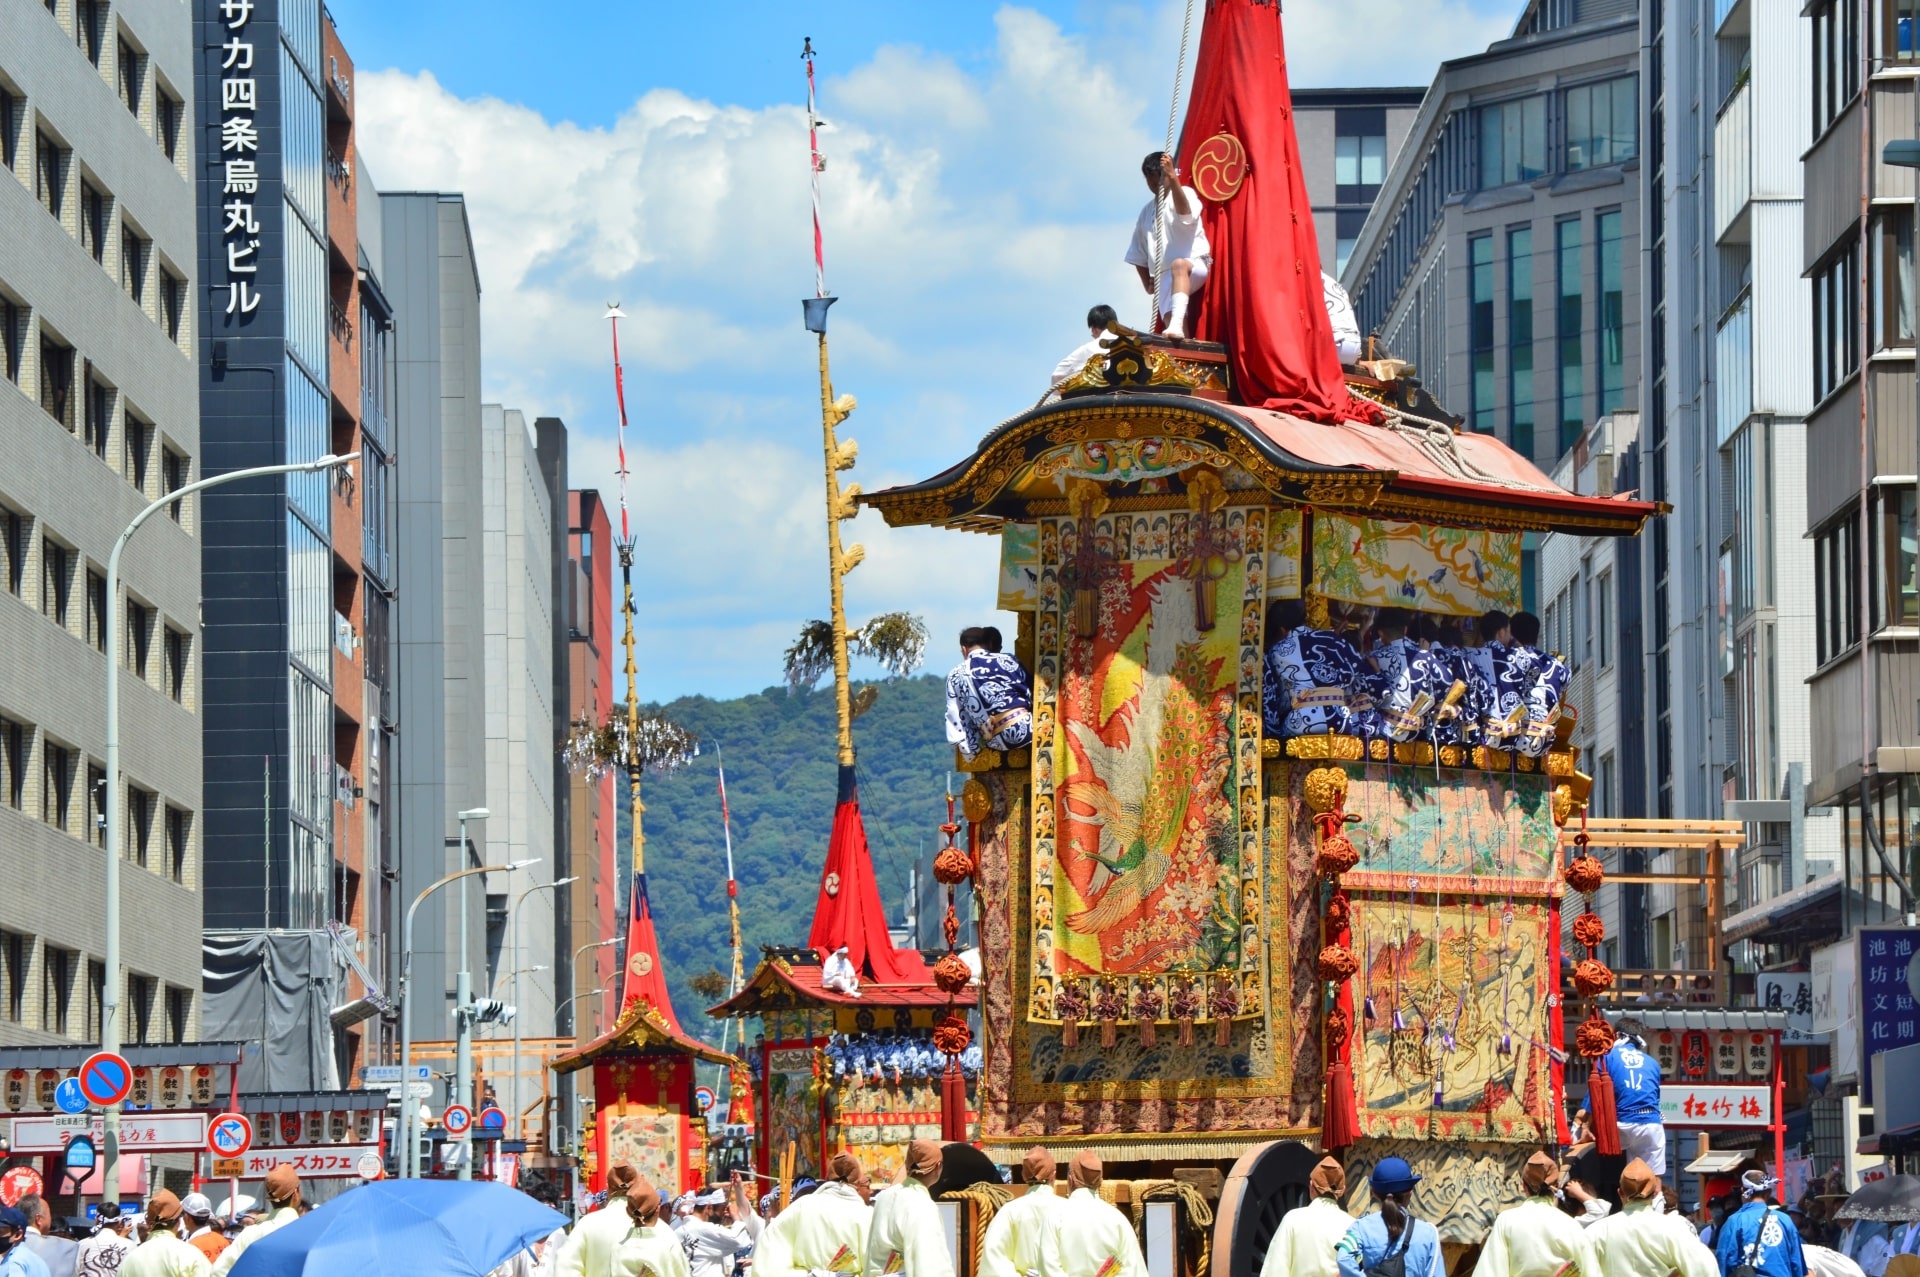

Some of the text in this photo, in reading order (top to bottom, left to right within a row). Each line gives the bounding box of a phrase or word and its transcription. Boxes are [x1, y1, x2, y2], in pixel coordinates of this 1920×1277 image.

[219, 0, 261, 314] サカ四条烏丸ビル
[1869, 938, 1889, 1055] 池坊文化
[1682, 1092, 1763, 1119] 松竹梅
[250, 1155, 352, 1172] ホリーズカフェ
